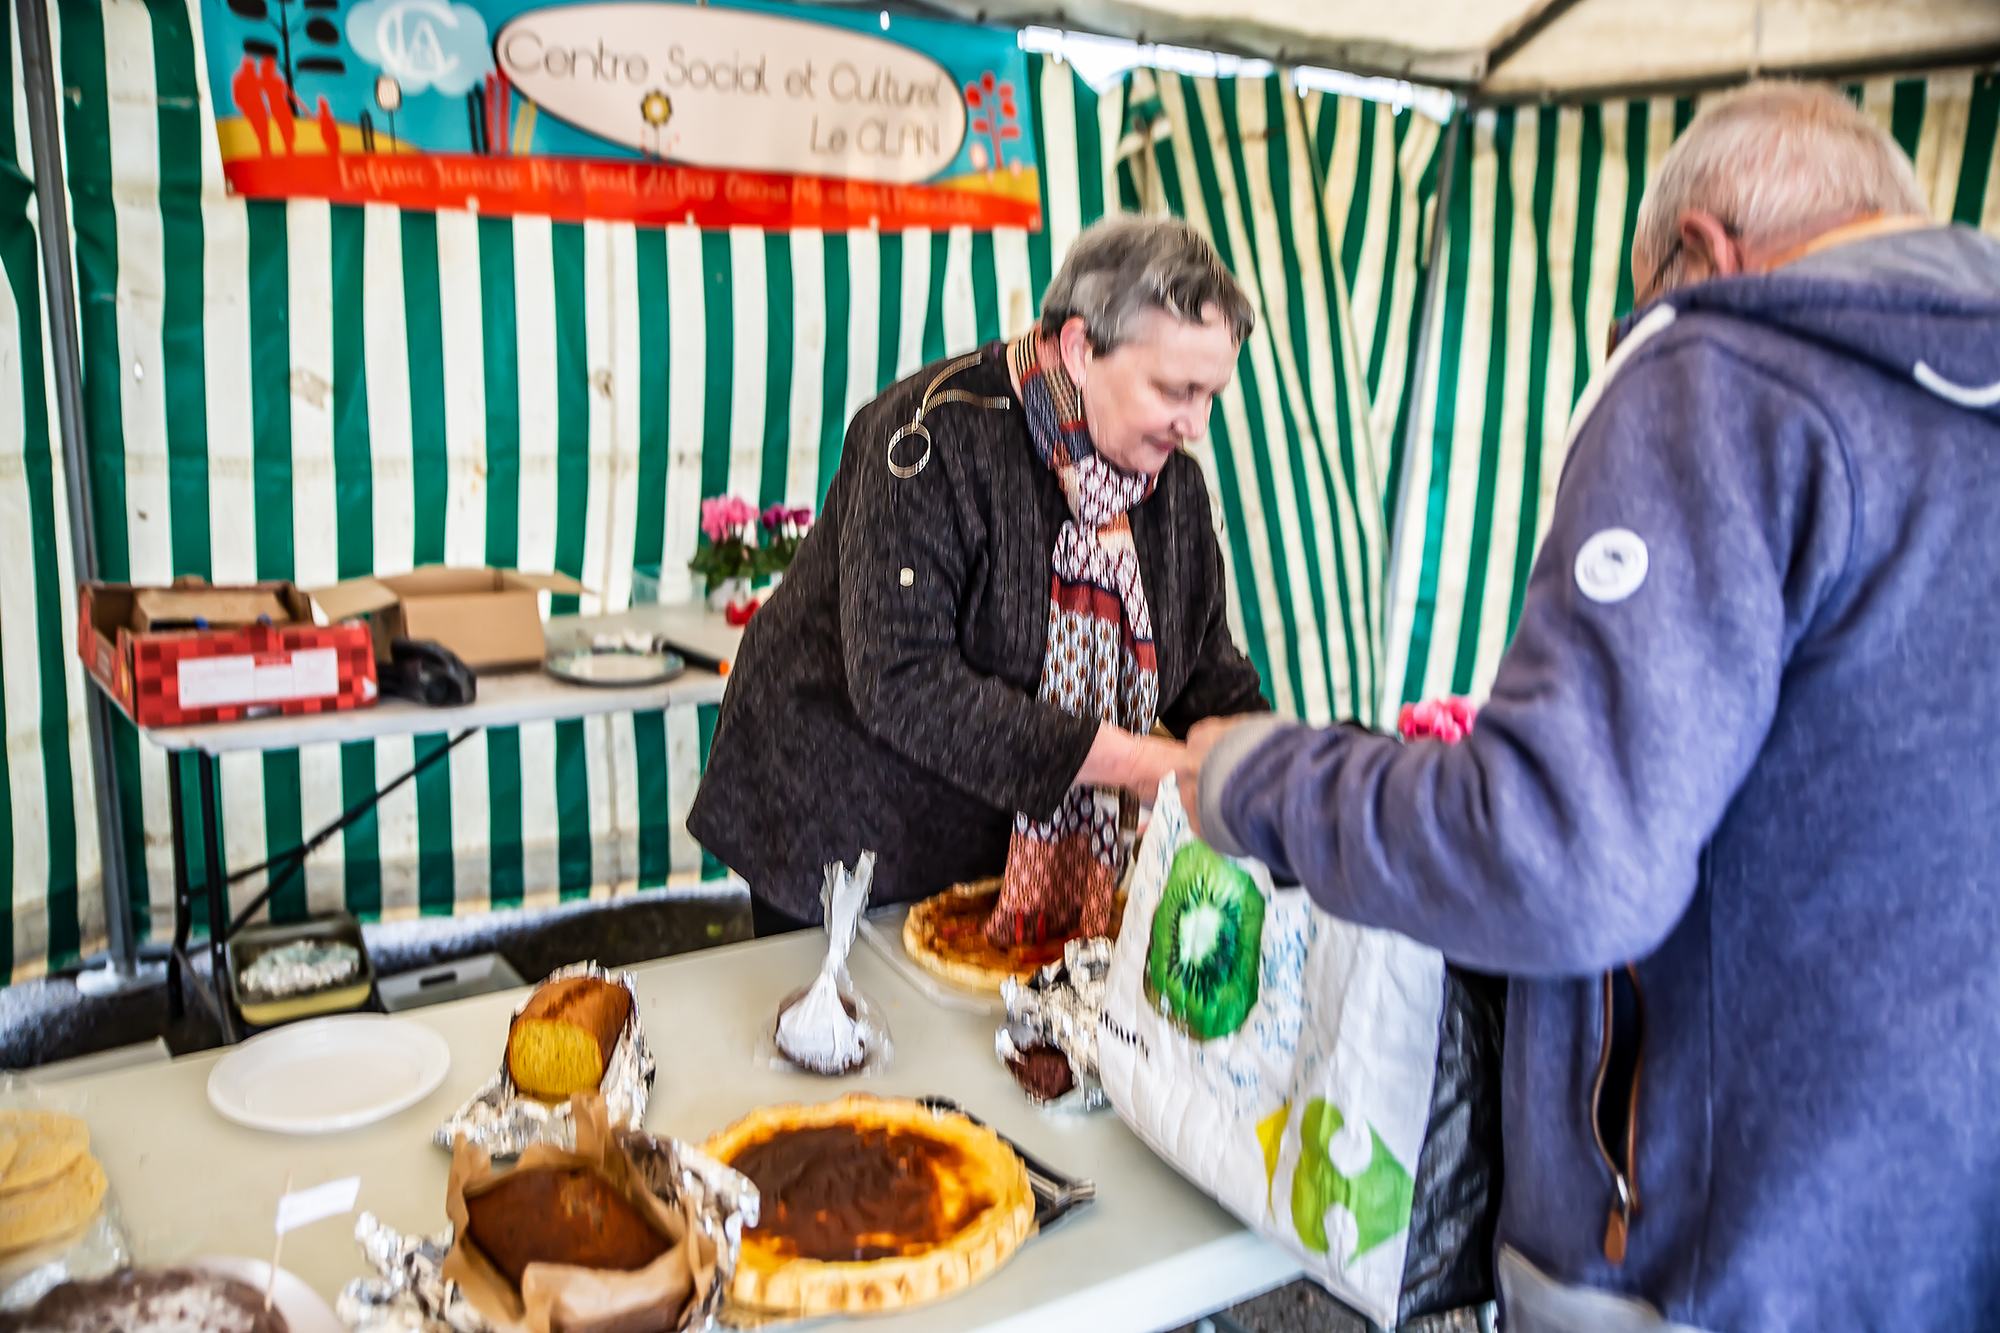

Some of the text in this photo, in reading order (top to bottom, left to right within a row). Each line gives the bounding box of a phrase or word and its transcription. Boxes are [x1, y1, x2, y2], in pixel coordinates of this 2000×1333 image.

[503, 29, 650, 87] Centre
[662, 41, 771, 97] Social
[783, 56, 816, 102] et
[809, 111, 849, 156] Le
